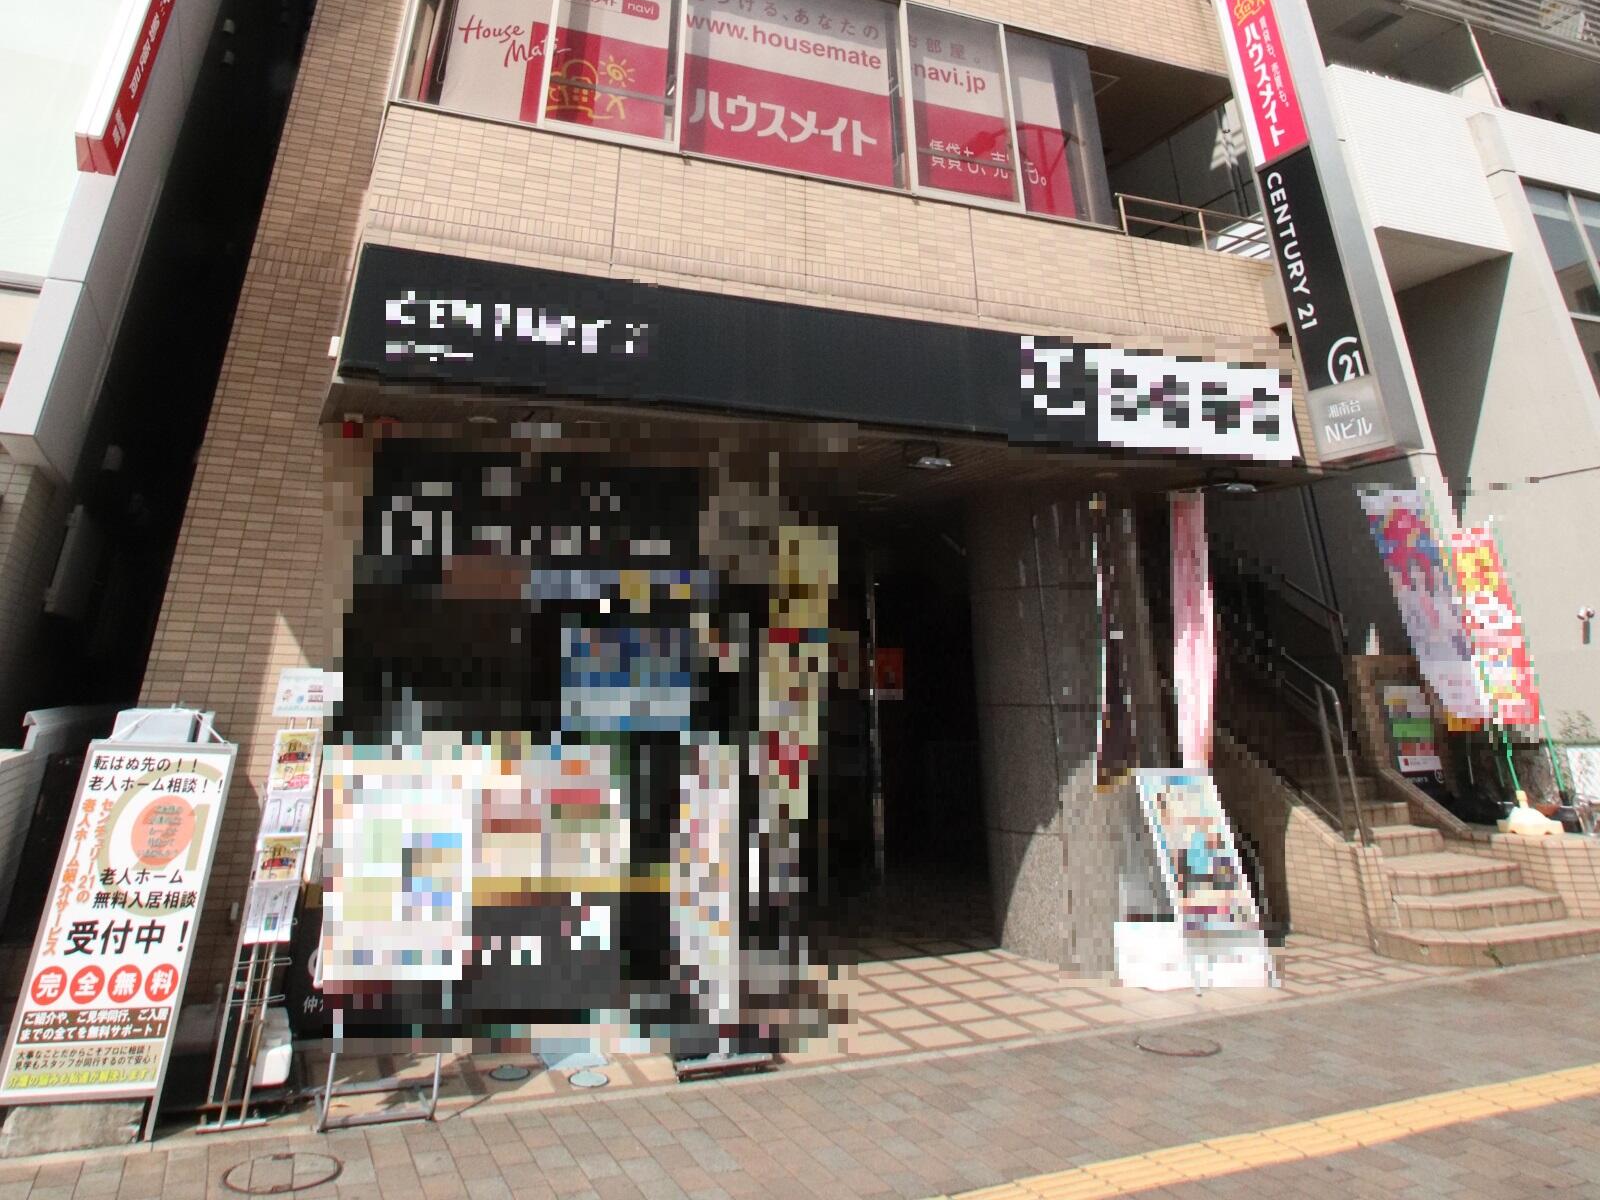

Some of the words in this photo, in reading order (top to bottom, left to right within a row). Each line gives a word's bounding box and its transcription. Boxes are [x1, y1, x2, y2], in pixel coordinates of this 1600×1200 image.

[627, 0, 655, 15] navi
[458, 14, 525, 44] House
[504, 35, 572, 67] Mat
[912, 62, 986, 94] navi.jp
[1244, 22, 1286, 148] ハウスメイト
[689, 88, 878, 157] ハウスメイト
[929, 138, 1047, 186] 賃貸も、売も。
[1266, 171, 1311, 296] CENTURY
[1297, 305, 1318, 330] 21
[1338, 349, 1365, 380] 21
[1324, 416, 1373, 444] Nビル
[93, 755, 198, 773] 転ばぬ先の！！
[88, 775, 224, 794] 老人ホーム相談！！
[43, 797, 97, 956] 老人ホーム紹介サービス
[99, 867, 184, 886] 老人ホーム
[92, 889, 198, 909] 無料入居相談
[63, 919, 190, 956] 受付中！
[36, 968, 174, 999] 完全無料
[18, 1022, 164, 1042] までの全てを無料サポート！
